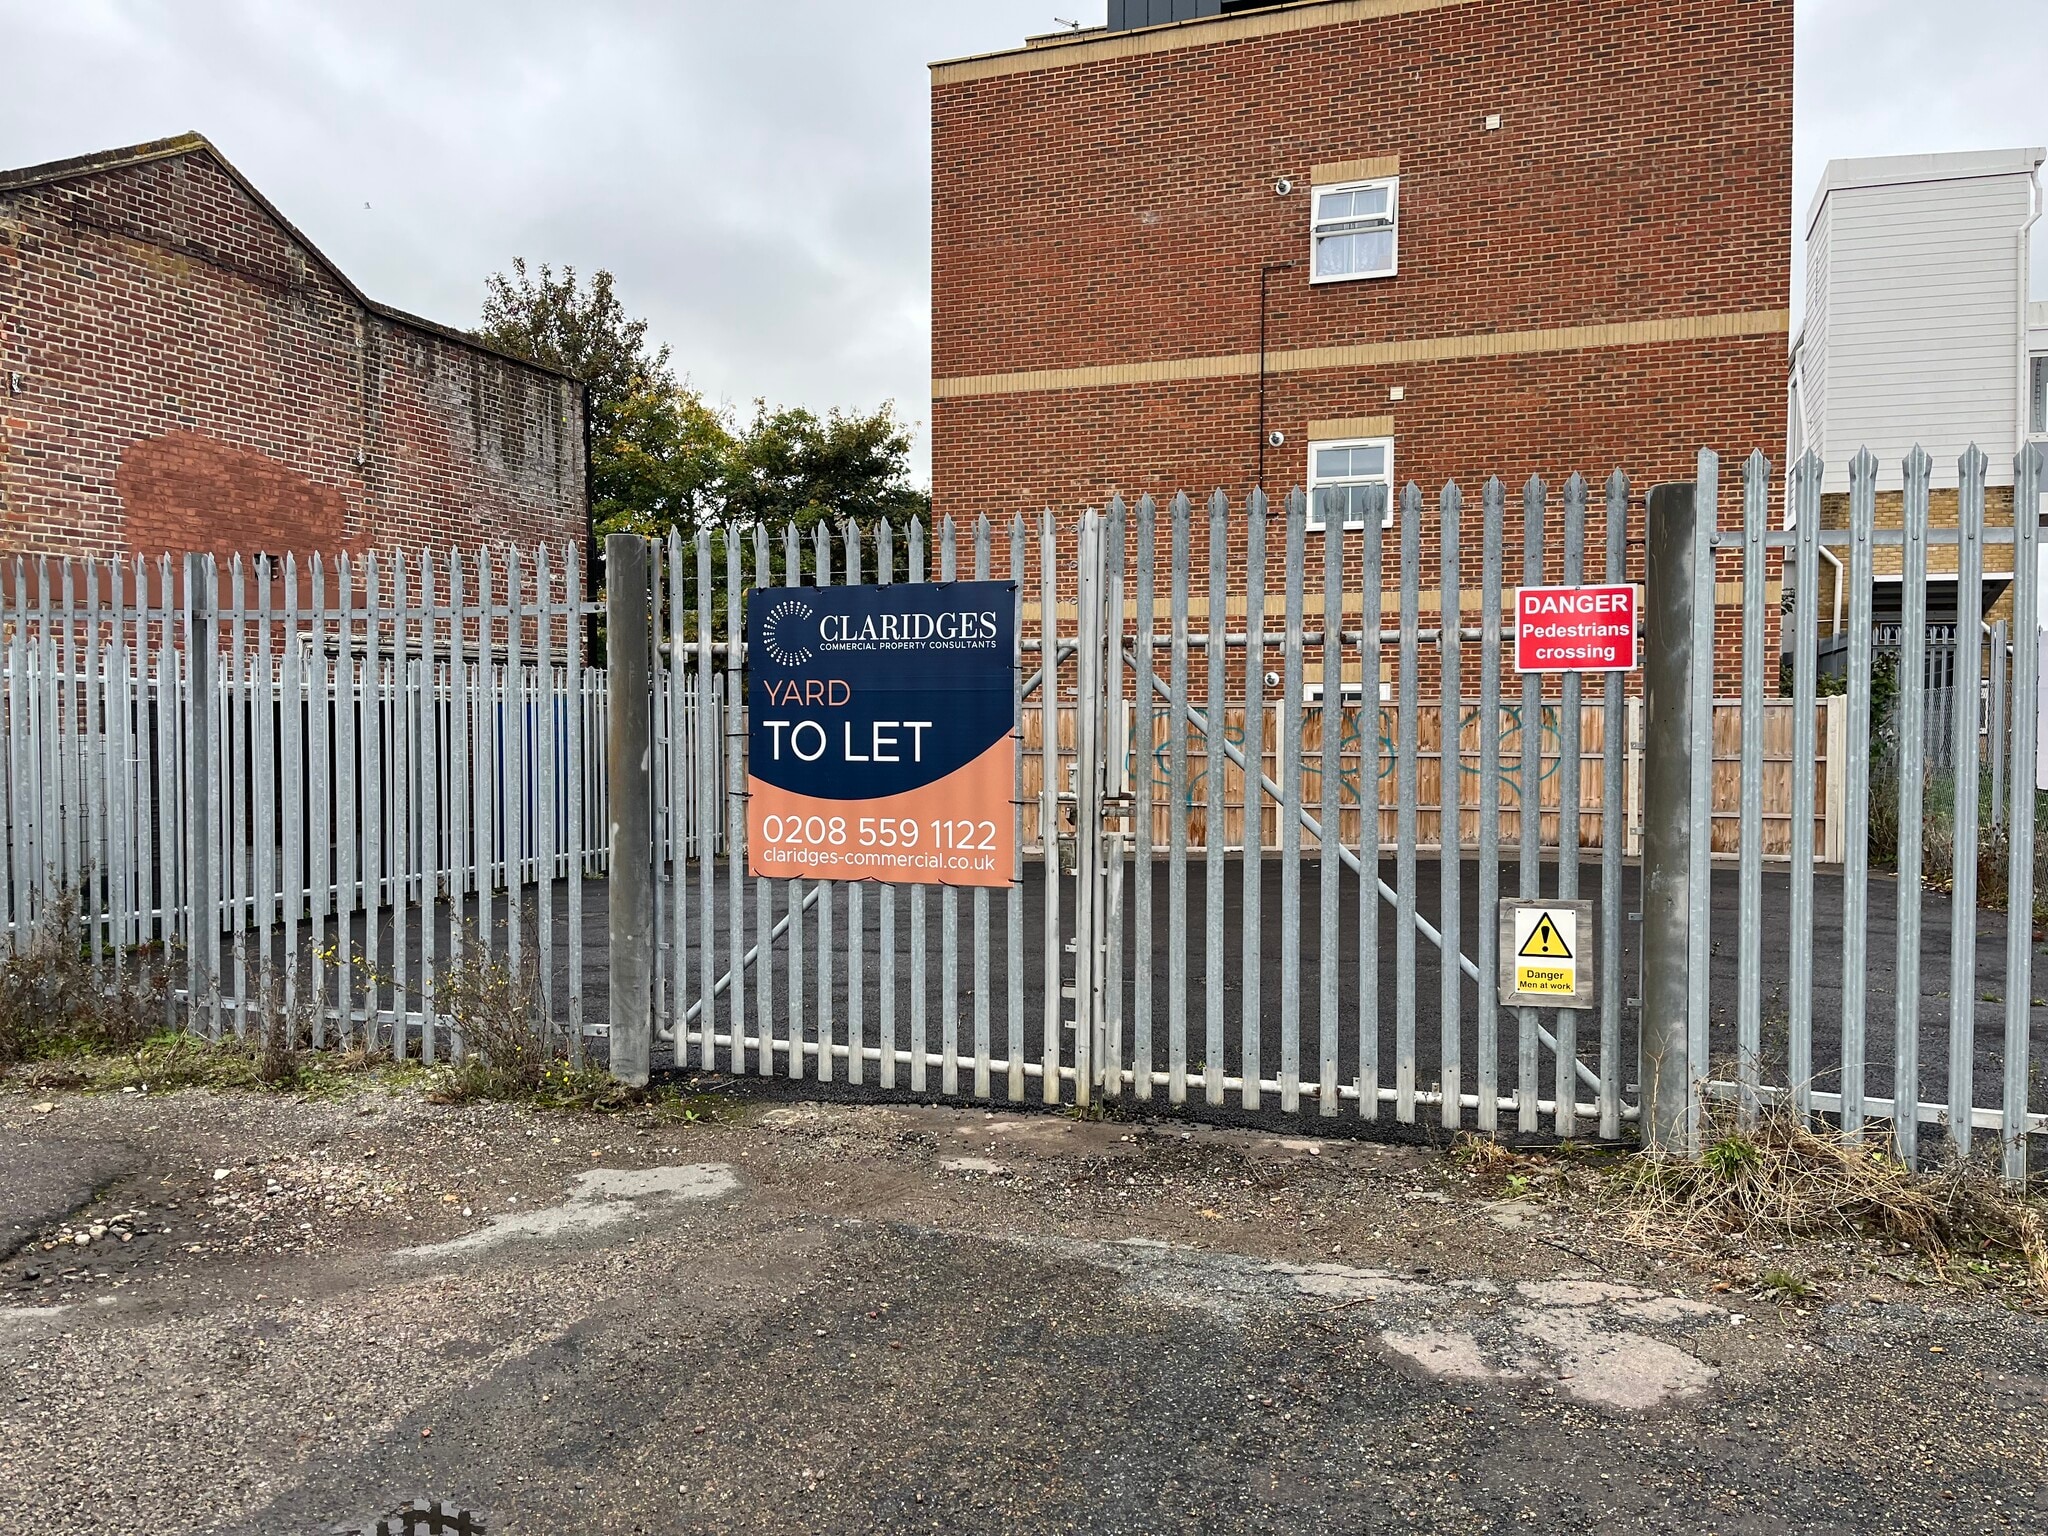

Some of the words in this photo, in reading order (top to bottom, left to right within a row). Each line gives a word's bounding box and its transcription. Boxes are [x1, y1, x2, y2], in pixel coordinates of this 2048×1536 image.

[1524, 594, 1628, 614] DANGER
[819, 611, 997, 642] CLARIDGES
[1522, 623, 1630, 638] Pedestrians
[819, 642, 877, 651] COMMERCIAL
[879, 641, 926, 650] PROPERTY
[929, 640, 997, 649] CONSULTANTS
[1535, 644, 1616, 662] crossing
[763, 679, 851, 706] YARD
[763, 720, 827, 762] TO
[844, 721, 933, 762] LET
[763, 815, 847, 845] 0208
[858, 817, 919, 848] 559
[930, 819, 997, 850] 1122
[763, 847, 996, 871] claridges-commercial.co.uk
[1527, 970, 1564, 981] Danger
